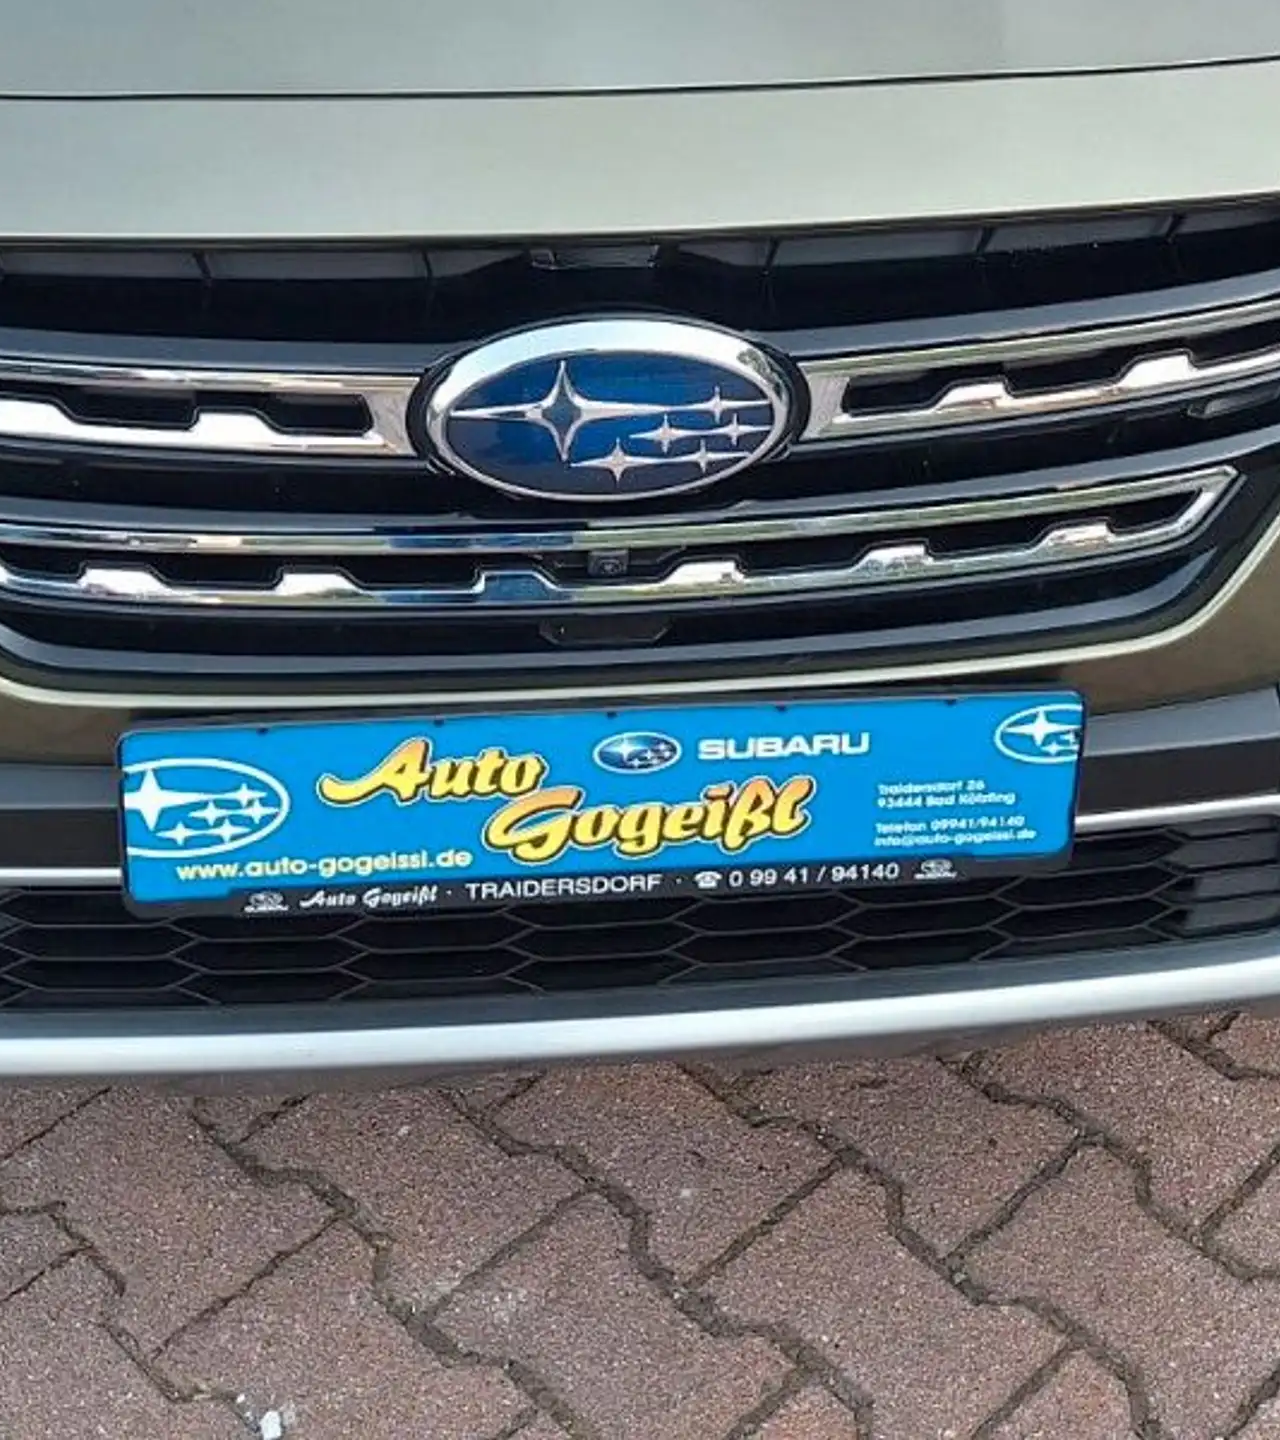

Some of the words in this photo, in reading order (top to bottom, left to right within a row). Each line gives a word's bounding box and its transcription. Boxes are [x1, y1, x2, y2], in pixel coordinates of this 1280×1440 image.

[698, 732, 870, 761] SUBARU
[317, 737, 549, 805] Auto
[925, 793, 955, 807] Bad
[484, 775, 816, 865] Gogeißl
[876, 821, 927, 833] Telefon
[176, 847, 473, 881] www.auto-gogeissl.de
[299, 890, 356, 909] Auto
[466, 872, 663, 901] TRAIDERSDORF
[728, 871, 743, 888] 0
[749, 869, 777, 887] 99
[783, 866, 808, 885] 41
[830, 861, 901, 883] 94140
